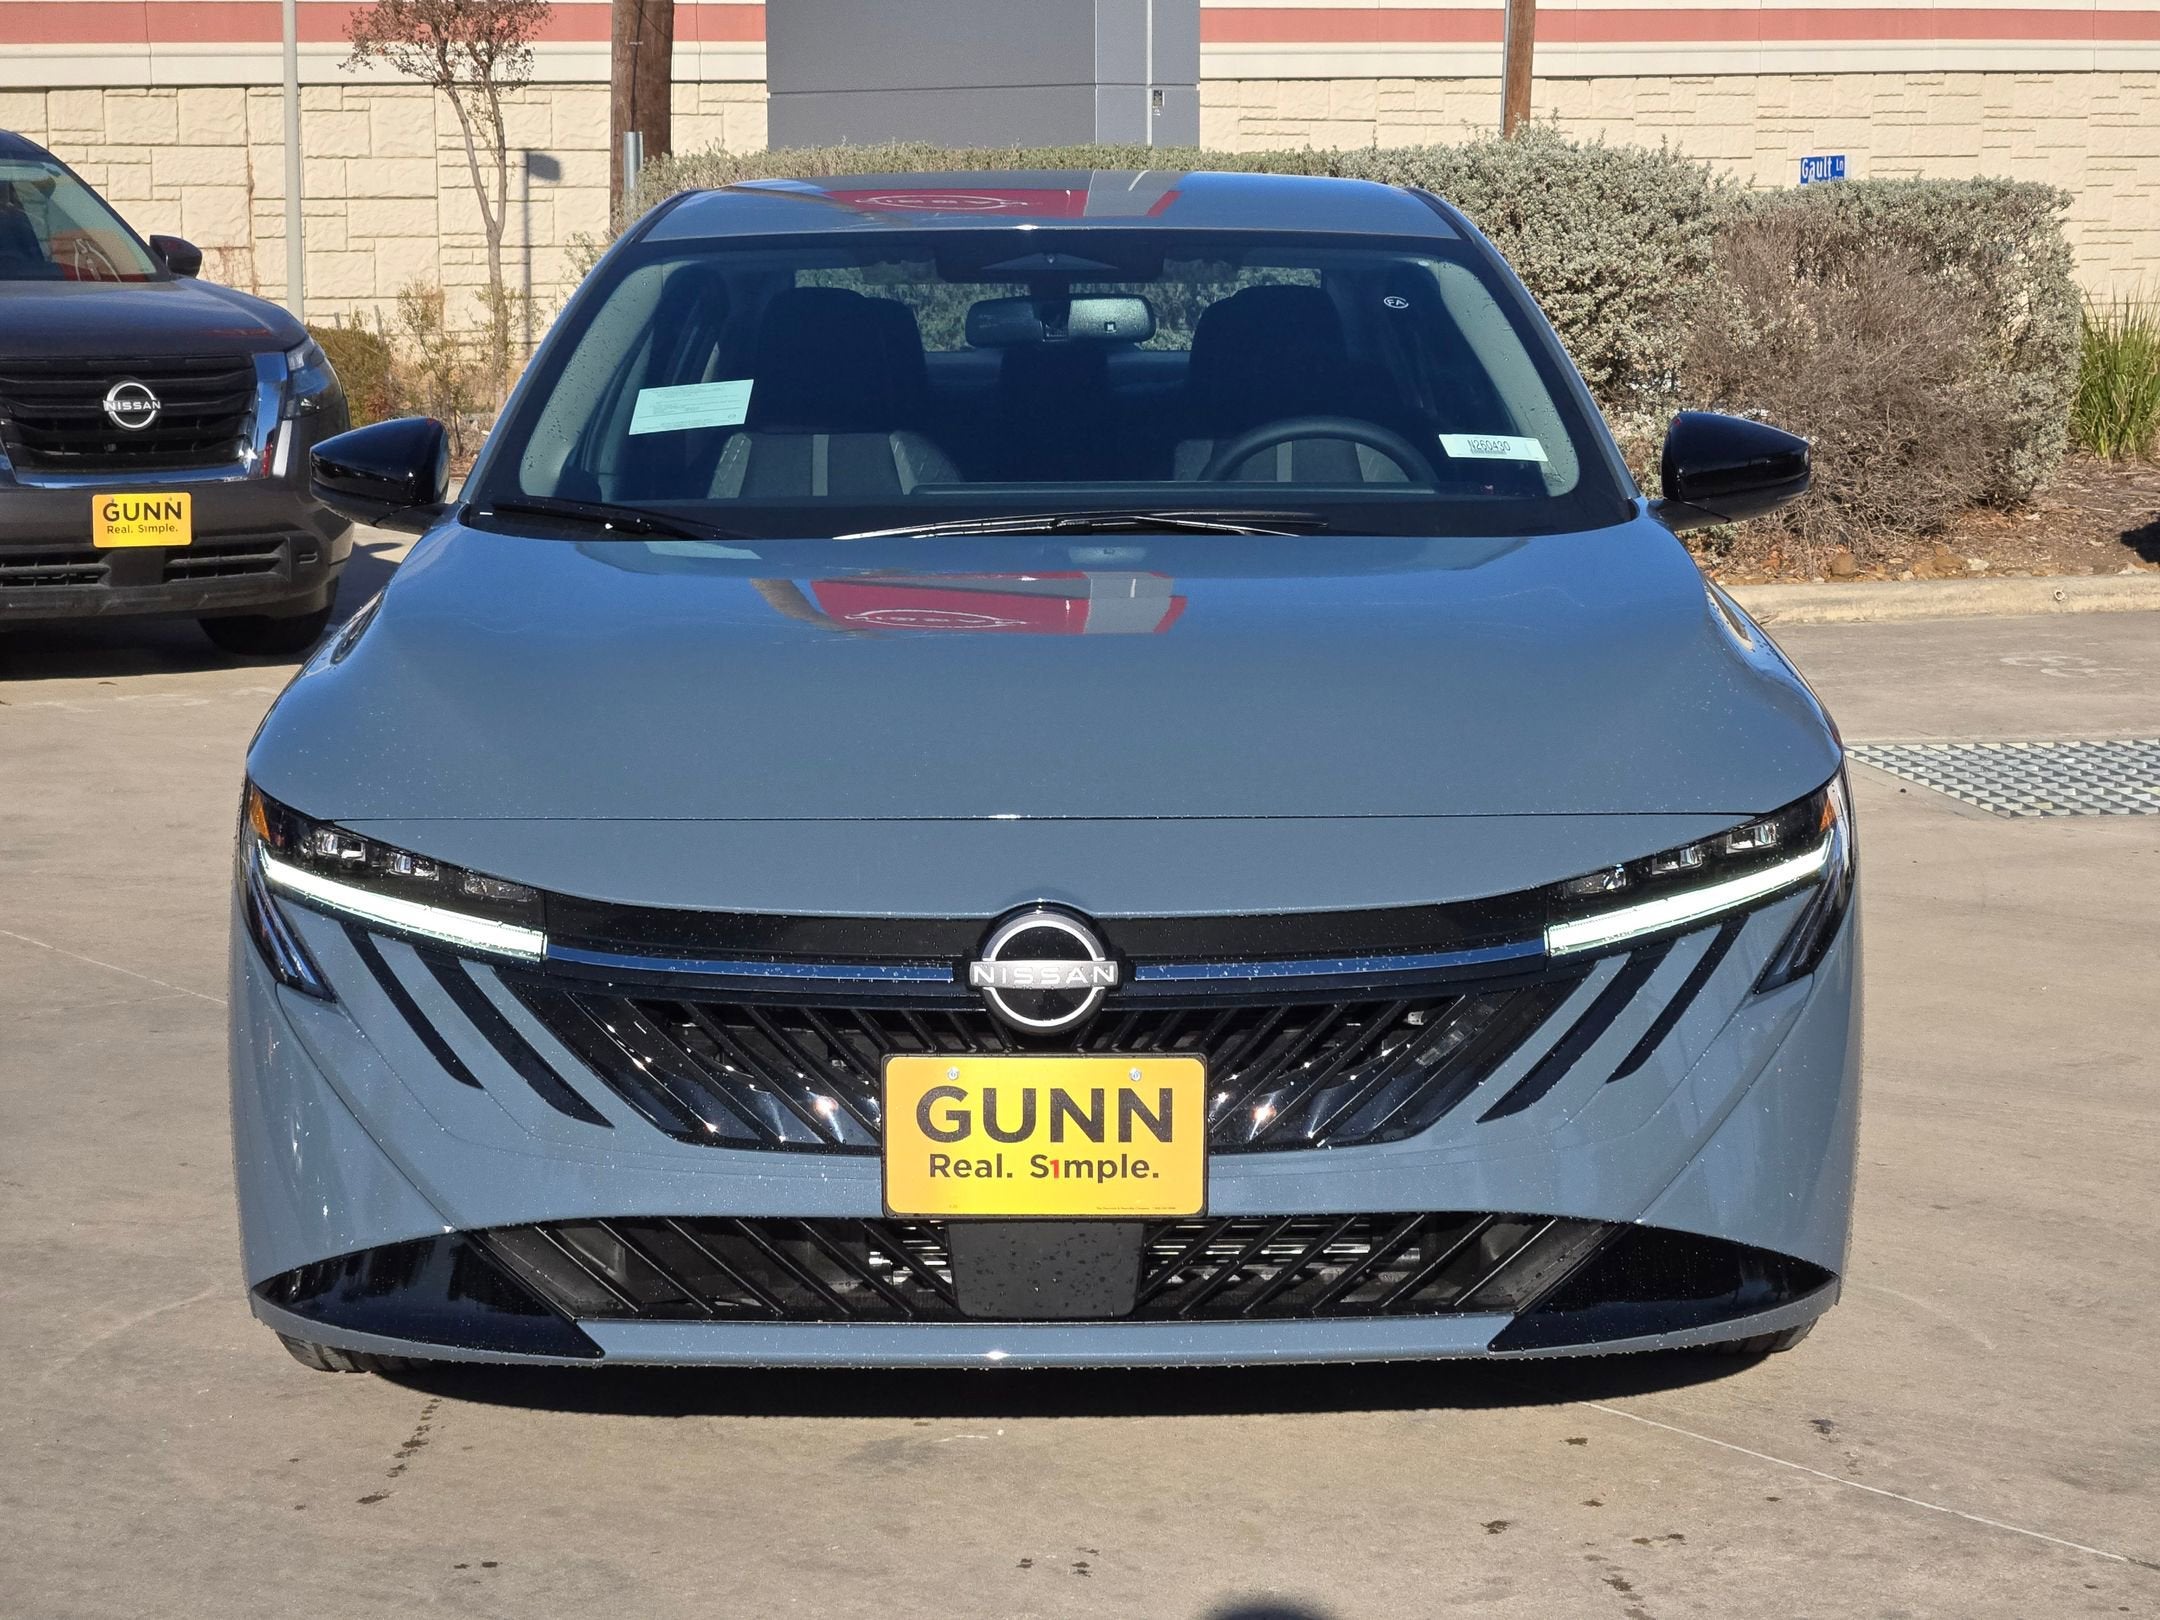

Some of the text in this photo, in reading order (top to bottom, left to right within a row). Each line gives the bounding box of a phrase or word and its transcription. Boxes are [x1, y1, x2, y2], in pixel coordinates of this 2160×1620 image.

[1802, 157, 1832, 179] Gault
[104, 400, 161, 411] NISSAN
[1467, 440, 1511, 452] N260430
[102, 501, 182, 522] GUNN
[106, 525, 133, 534] Real.
[973, 965, 1115, 984] NISSAN
[916, 1085, 1173, 1143] GUNN
[929, 1153, 1013, 1178] Real.
